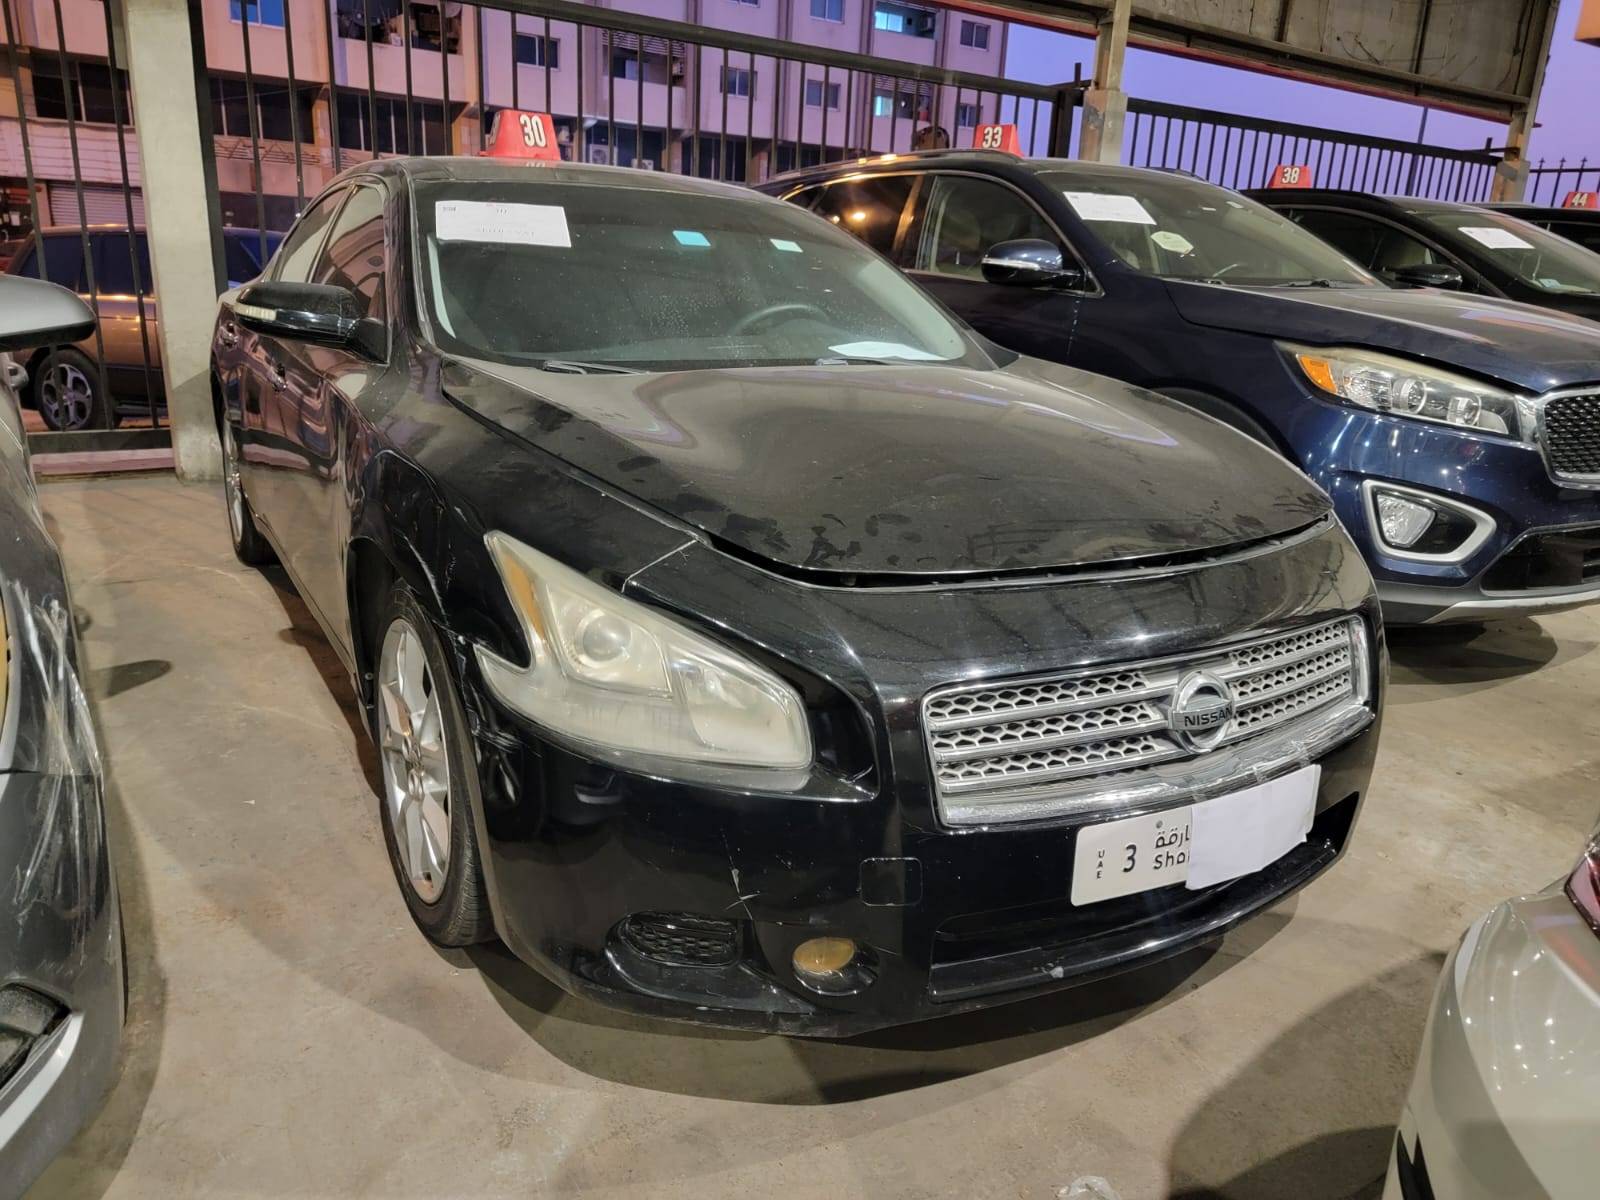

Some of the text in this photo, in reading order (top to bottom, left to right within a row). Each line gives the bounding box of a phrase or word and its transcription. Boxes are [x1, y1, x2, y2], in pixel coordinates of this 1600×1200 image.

[519, 113, 547, 148] 30
[982, 126, 1002, 149] 33
[1281, 167, 1300, 184] 38
[1571, 193, 1588, 207] 44
[1184, 703, 1233, 727] NISSAN
[1154, 824, 1190, 849] ارقة
[1122, 844, 1137, 873] 3
